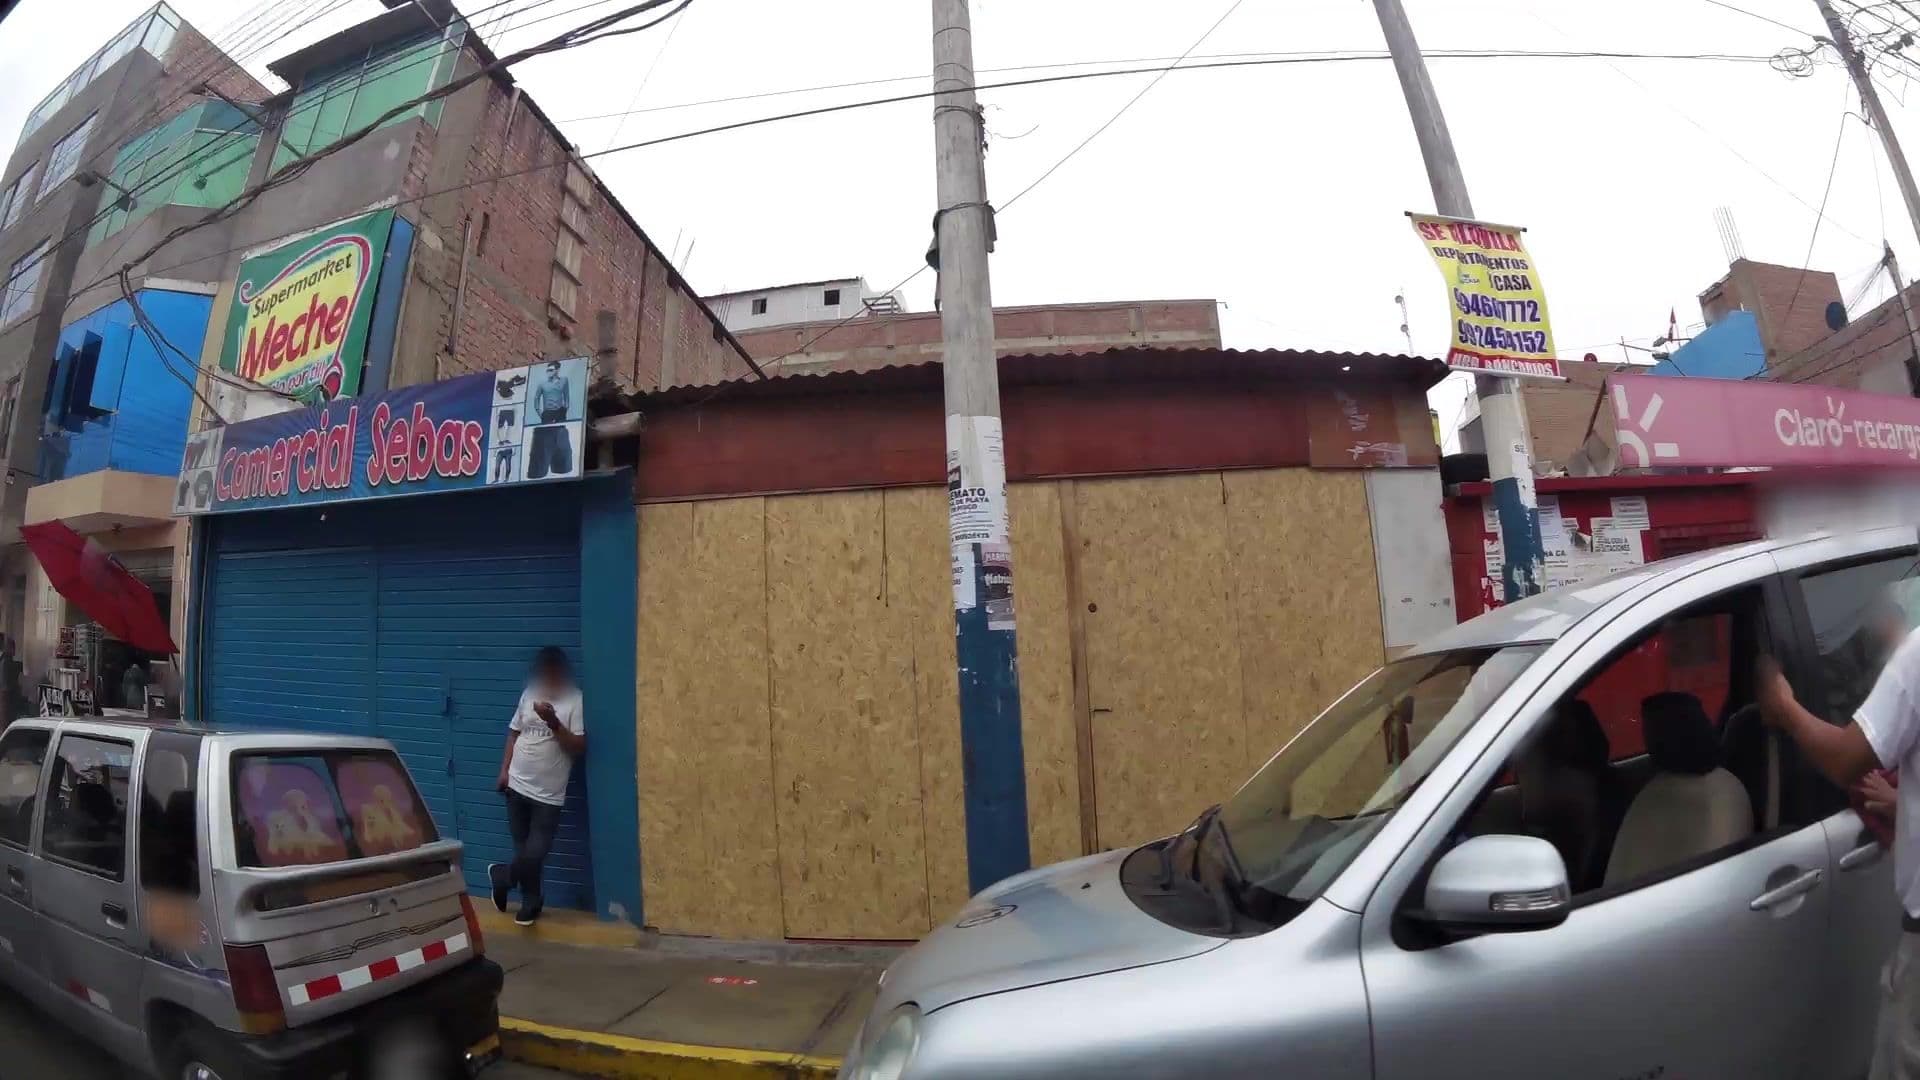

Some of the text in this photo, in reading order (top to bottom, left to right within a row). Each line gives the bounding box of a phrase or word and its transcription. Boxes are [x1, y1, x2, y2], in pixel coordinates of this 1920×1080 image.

[1417, 222, 1447, 241] SE
[252, 252, 353, 319] Supermarket
[1494, 273, 1532, 291] CASA
[240, 294, 350, 382] Meche
[1774, 396, 1845, 447] Claro
[216, 401, 484, 502] Comercial Sebas
